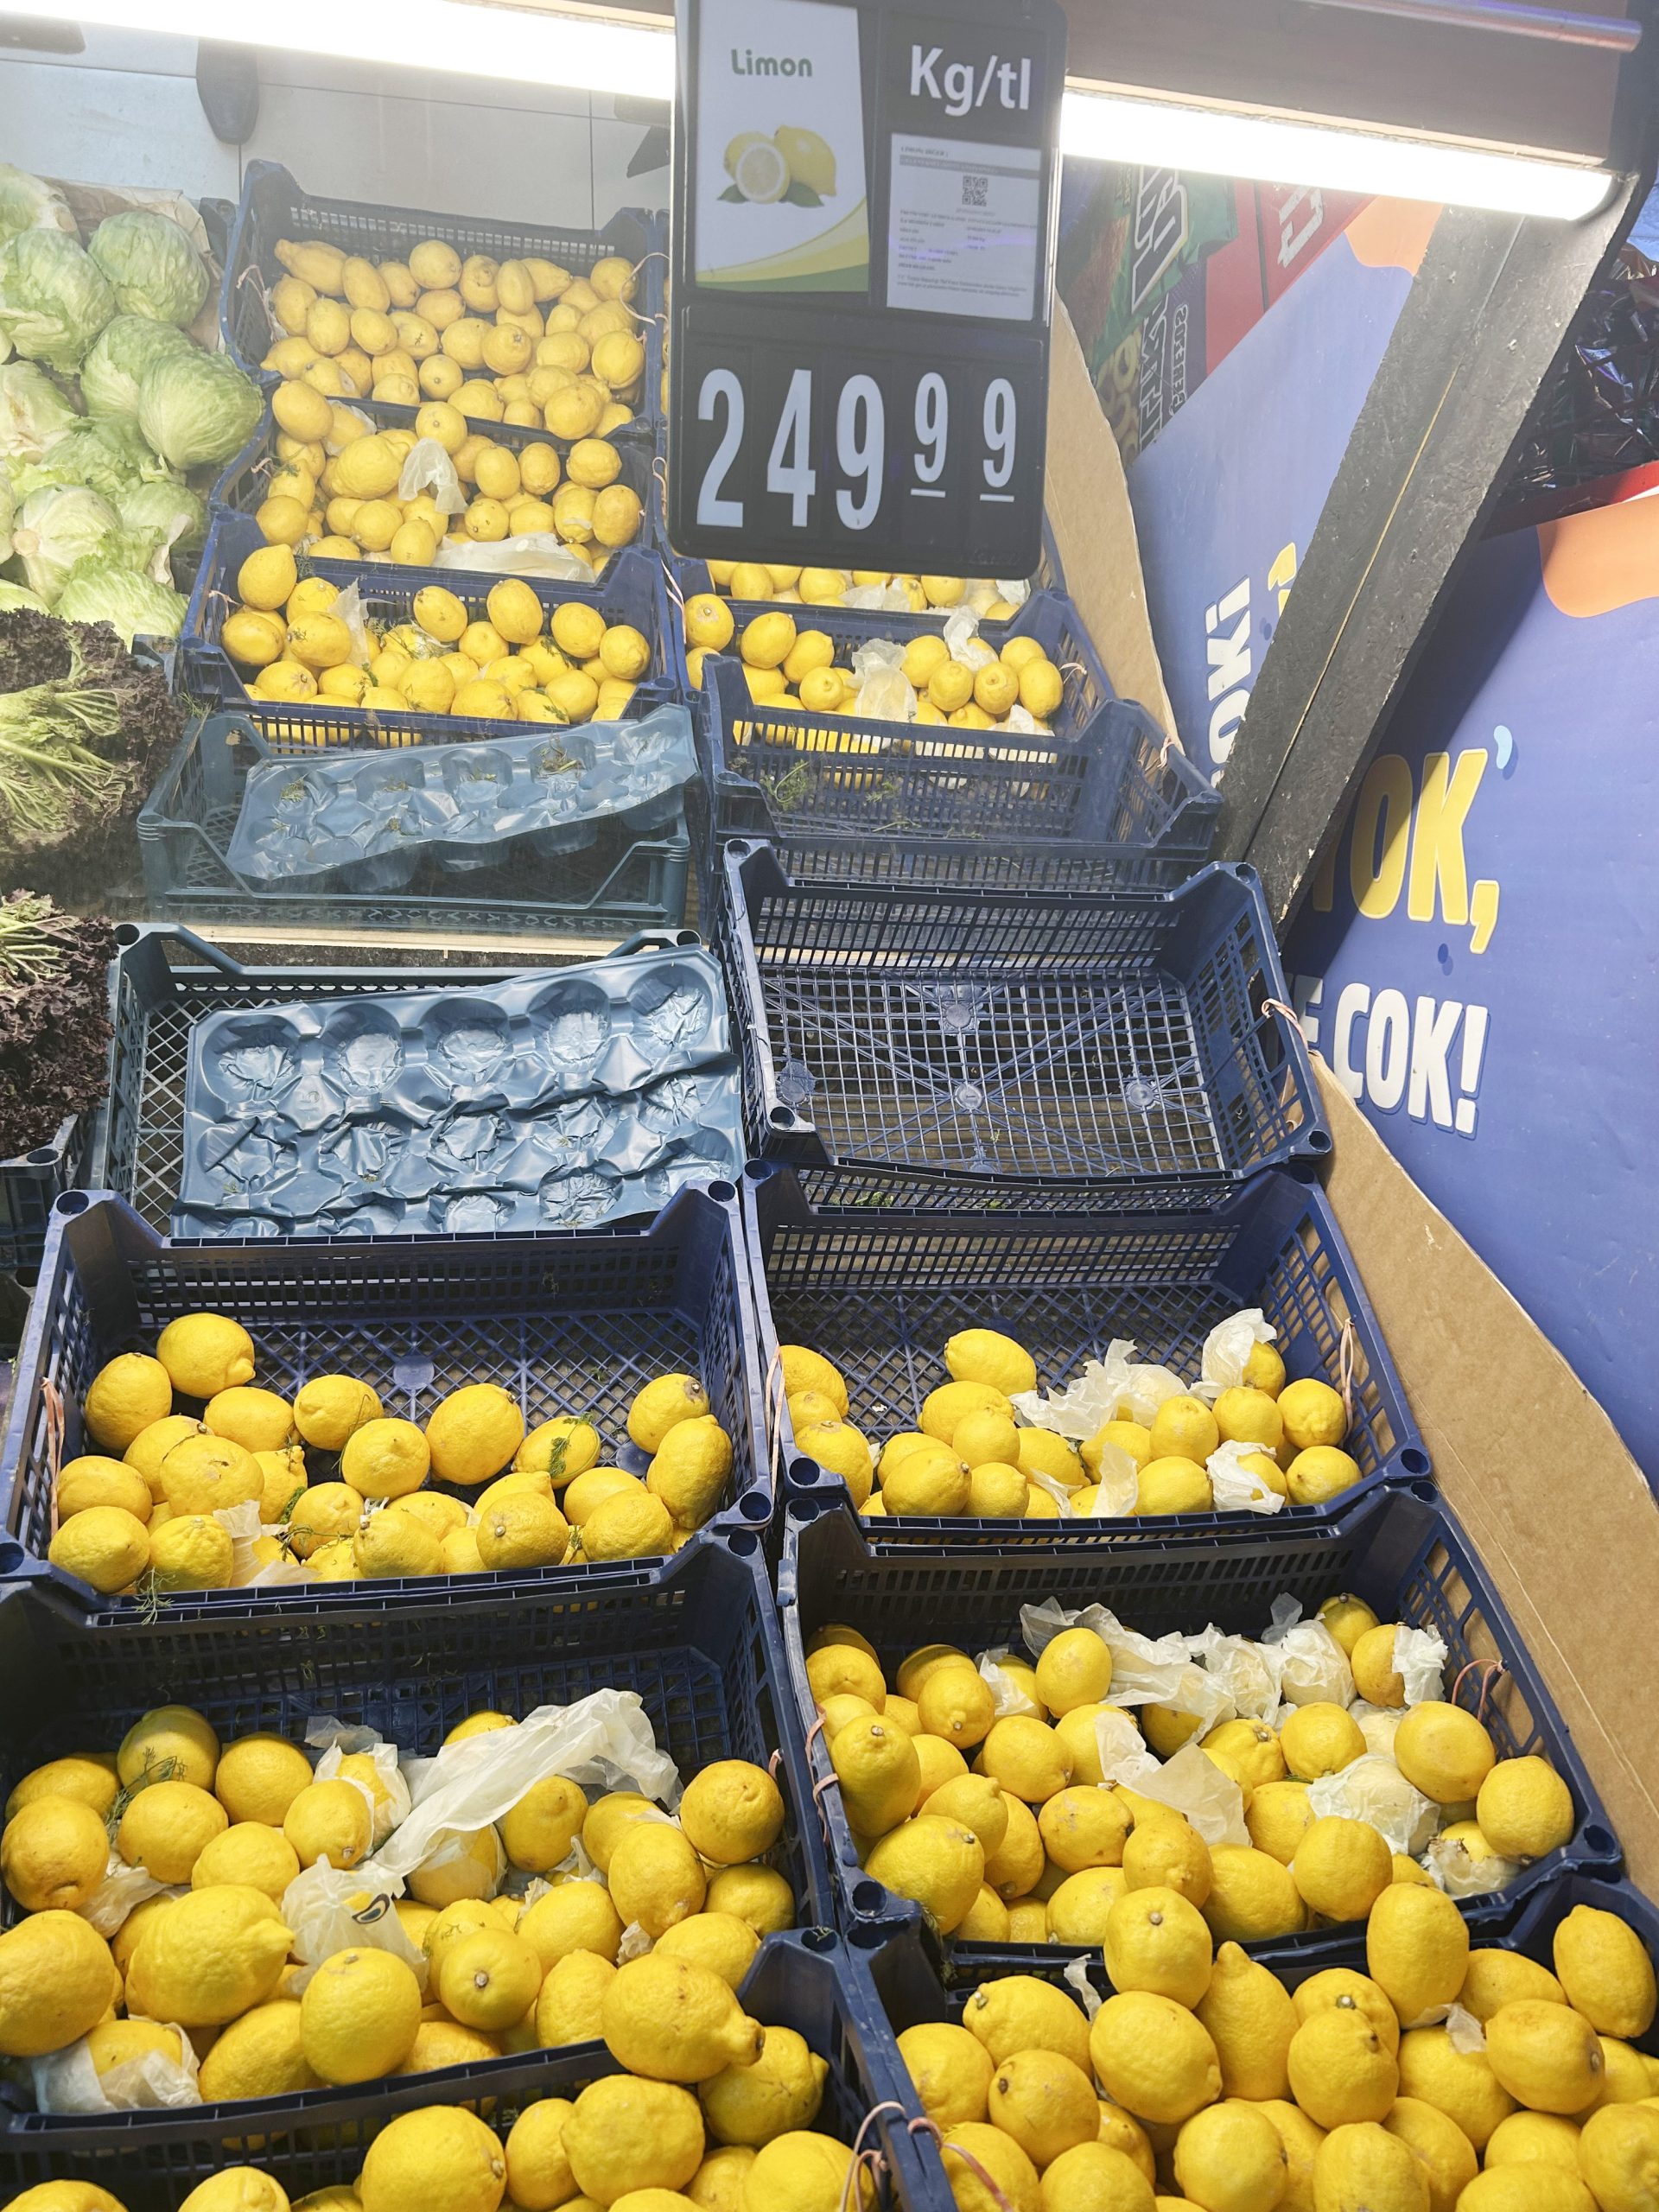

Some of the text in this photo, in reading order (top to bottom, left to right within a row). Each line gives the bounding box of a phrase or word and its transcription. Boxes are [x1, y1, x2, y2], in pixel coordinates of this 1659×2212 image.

[730, 48, 813, 78] Limon
[911, 44, 1032, 117] Kg/tl
[696, 367, 885, 531] 249
